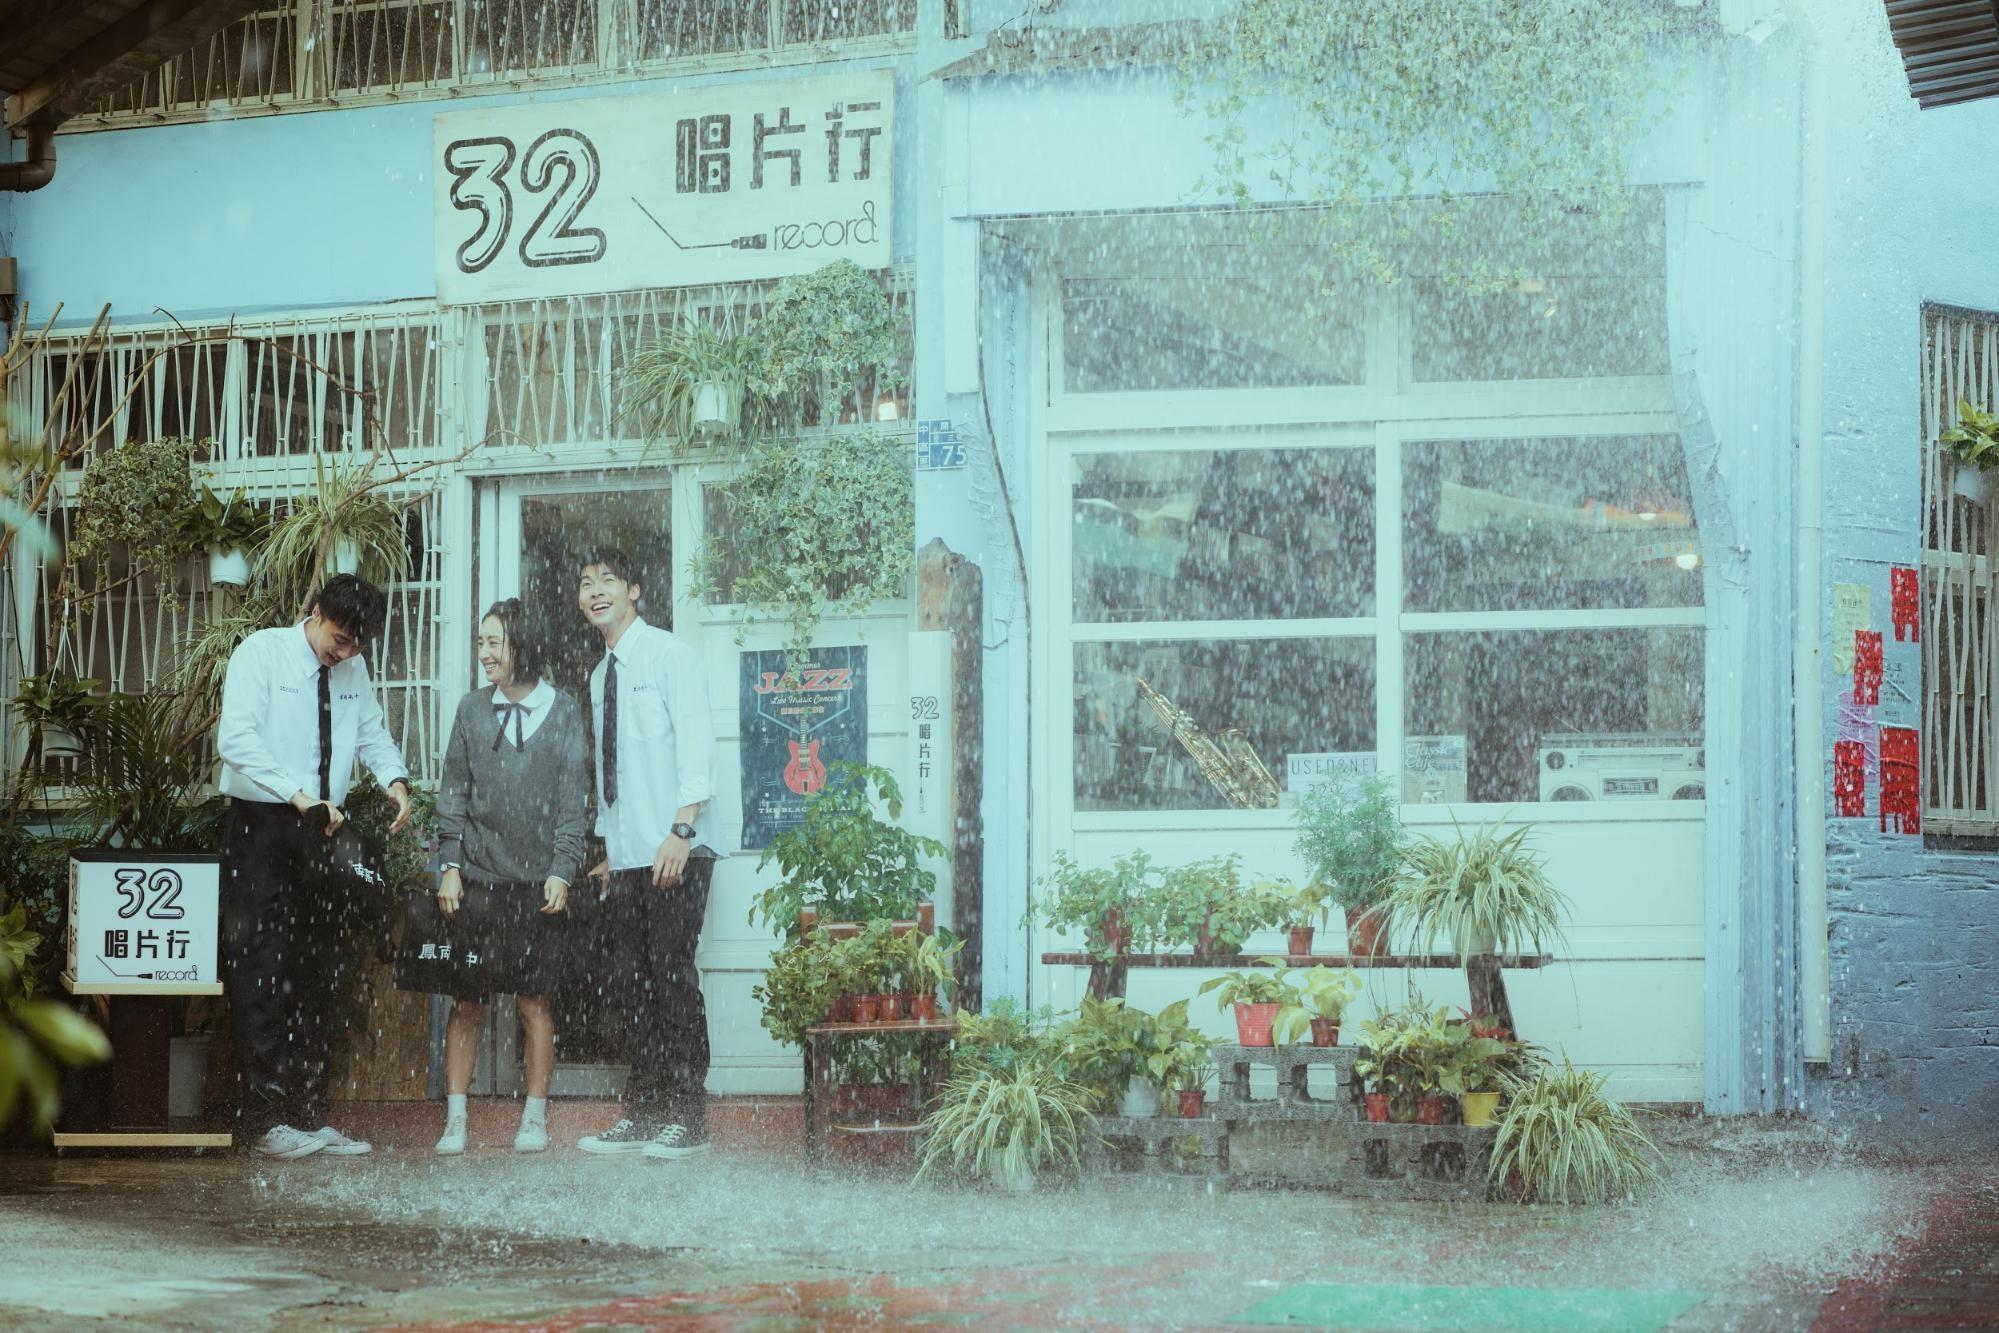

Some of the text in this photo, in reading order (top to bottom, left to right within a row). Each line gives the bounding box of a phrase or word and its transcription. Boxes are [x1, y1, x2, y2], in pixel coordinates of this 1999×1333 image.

[444, 101, 882, 274] 32 唱片行
[773, 200, 880, 252] record
[942, 445, 967, 466] 75
[754, 667, 853, 694] JAZZ
[910, 695, 940, 720] 32
[919, 723, 931, 779] 唱片行
[114, 867, 186, 920] 32
[104, 929, 191, 959] 唱片行
[155, 964, 199, 982] record
